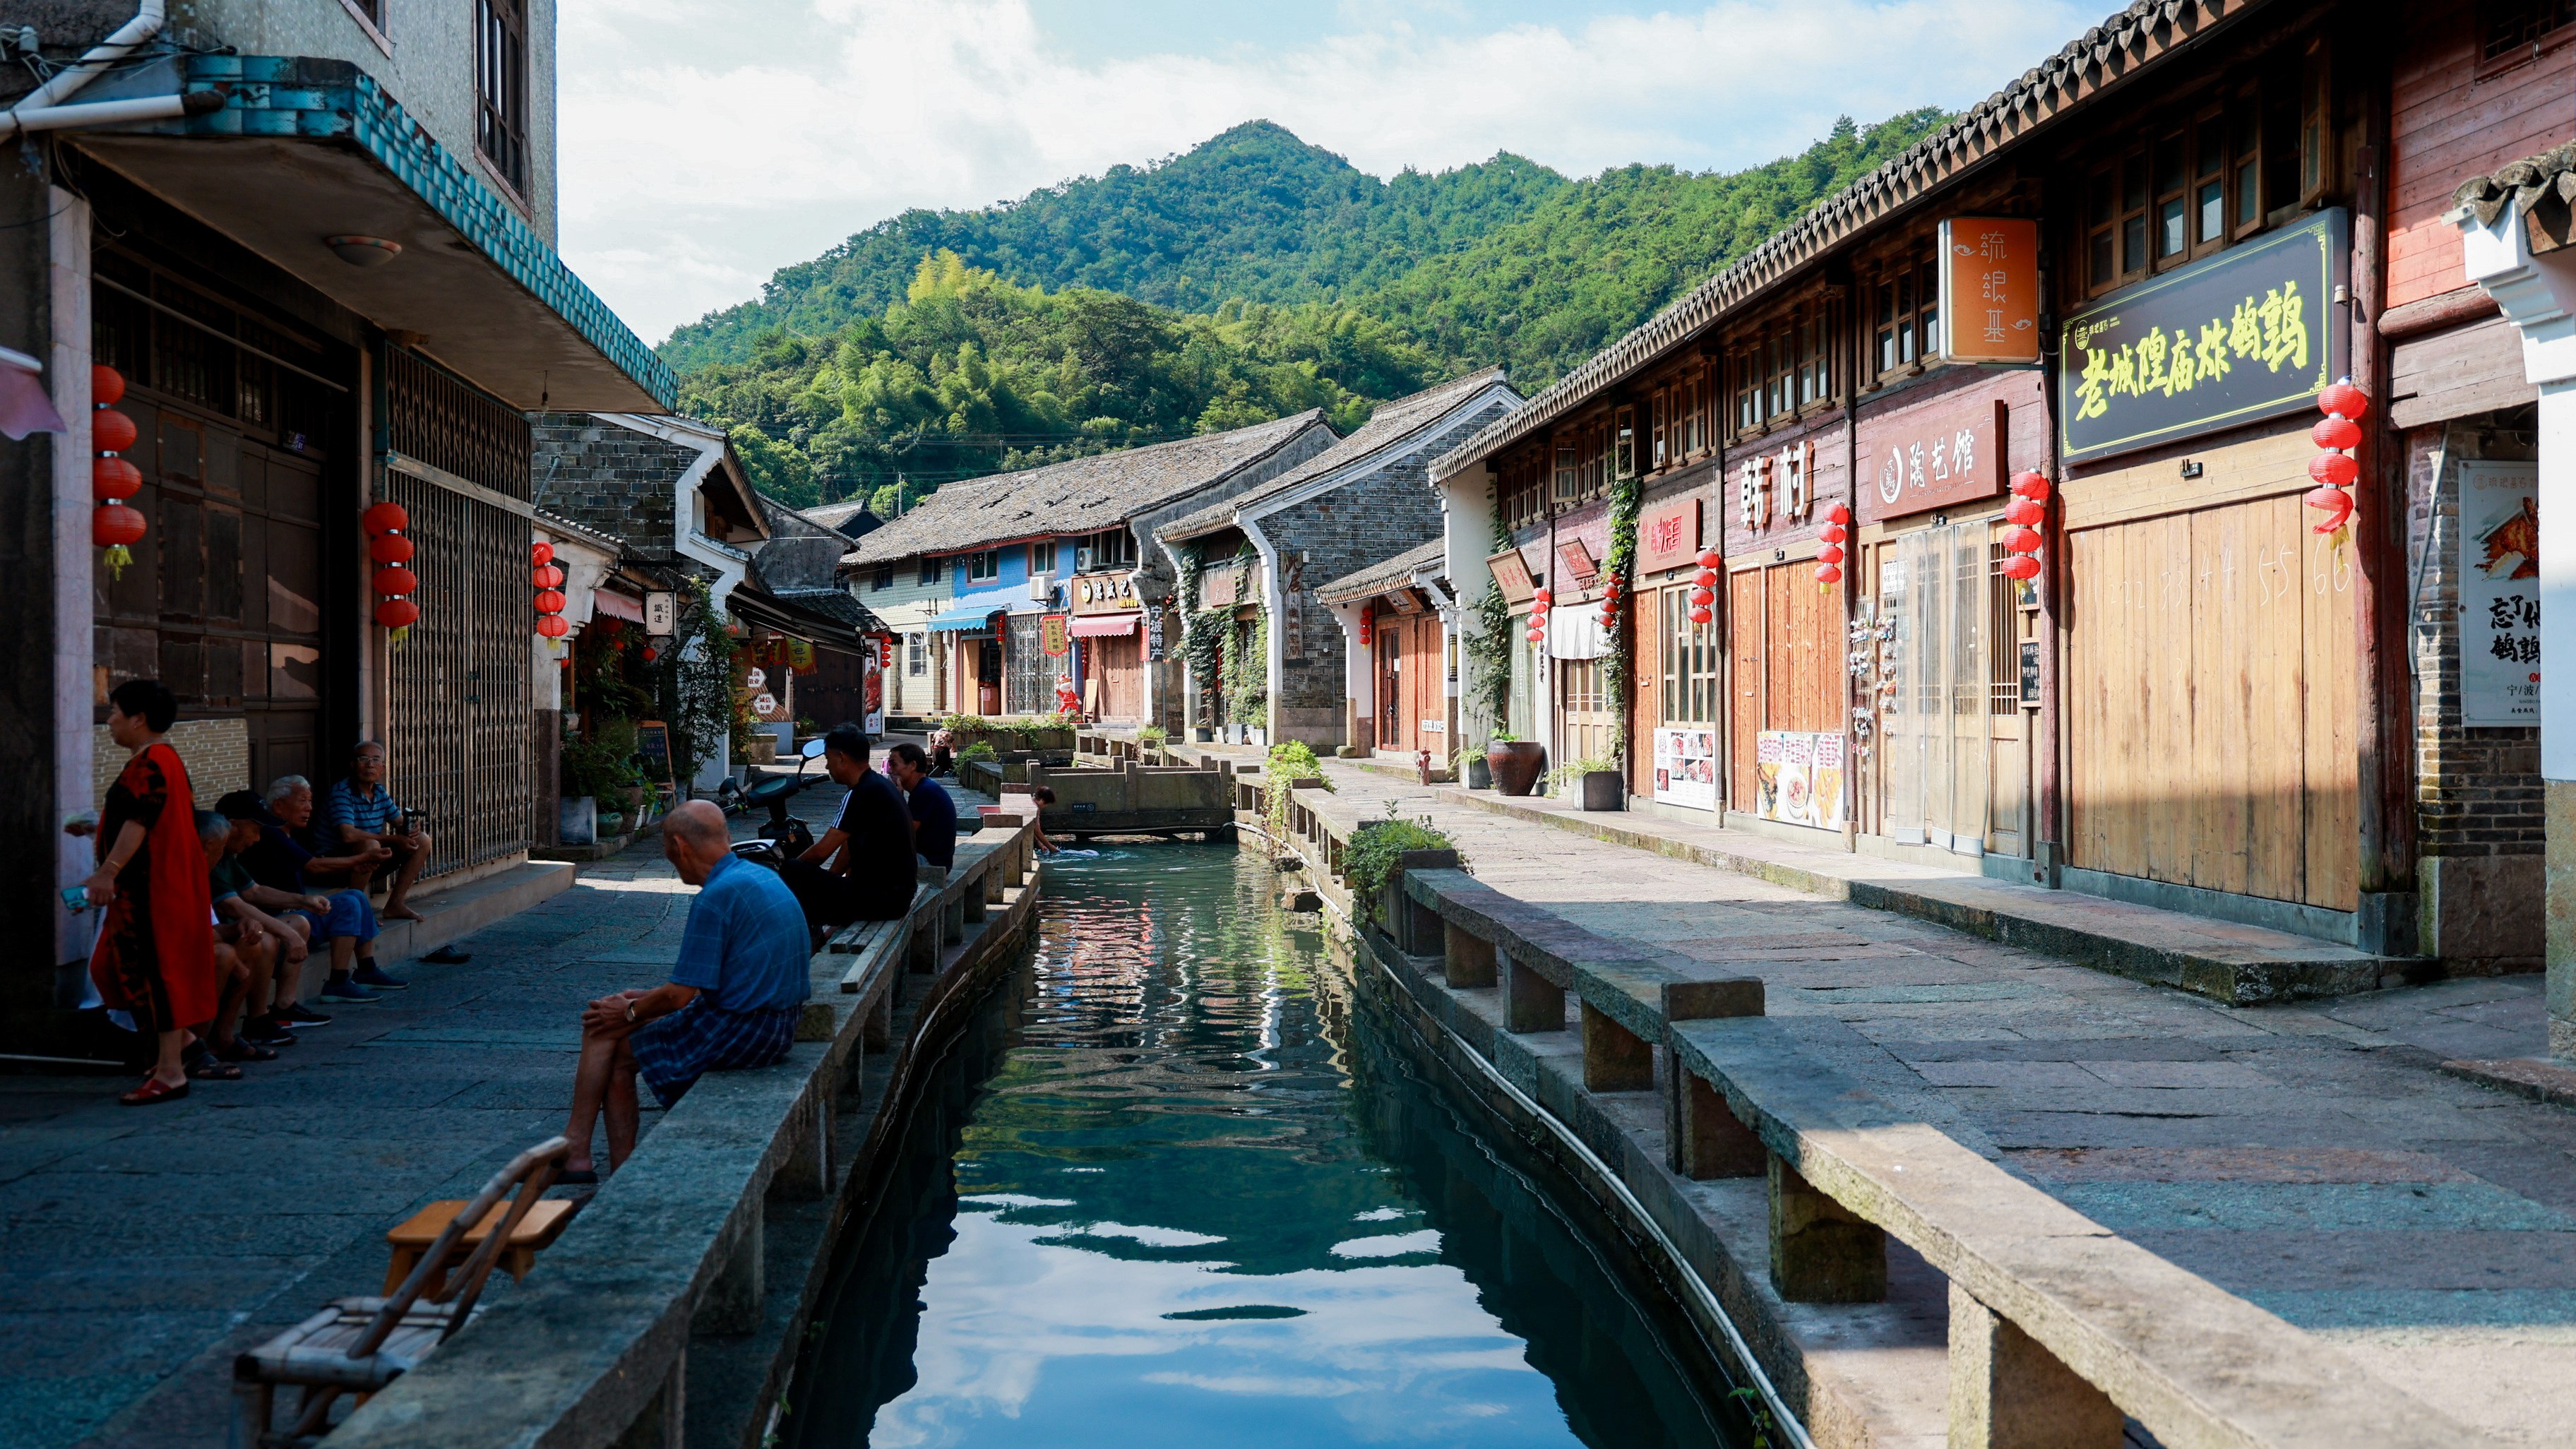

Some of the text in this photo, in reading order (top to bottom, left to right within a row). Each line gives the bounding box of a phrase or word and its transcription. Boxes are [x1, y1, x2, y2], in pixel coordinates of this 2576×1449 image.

[2075, 280, 2308, 422] 老城隍庙炸鹌鹑
[1150, 605, 1164, 660] 宁波特产
[2490, 633, 2540, 664] 鹌鹑
